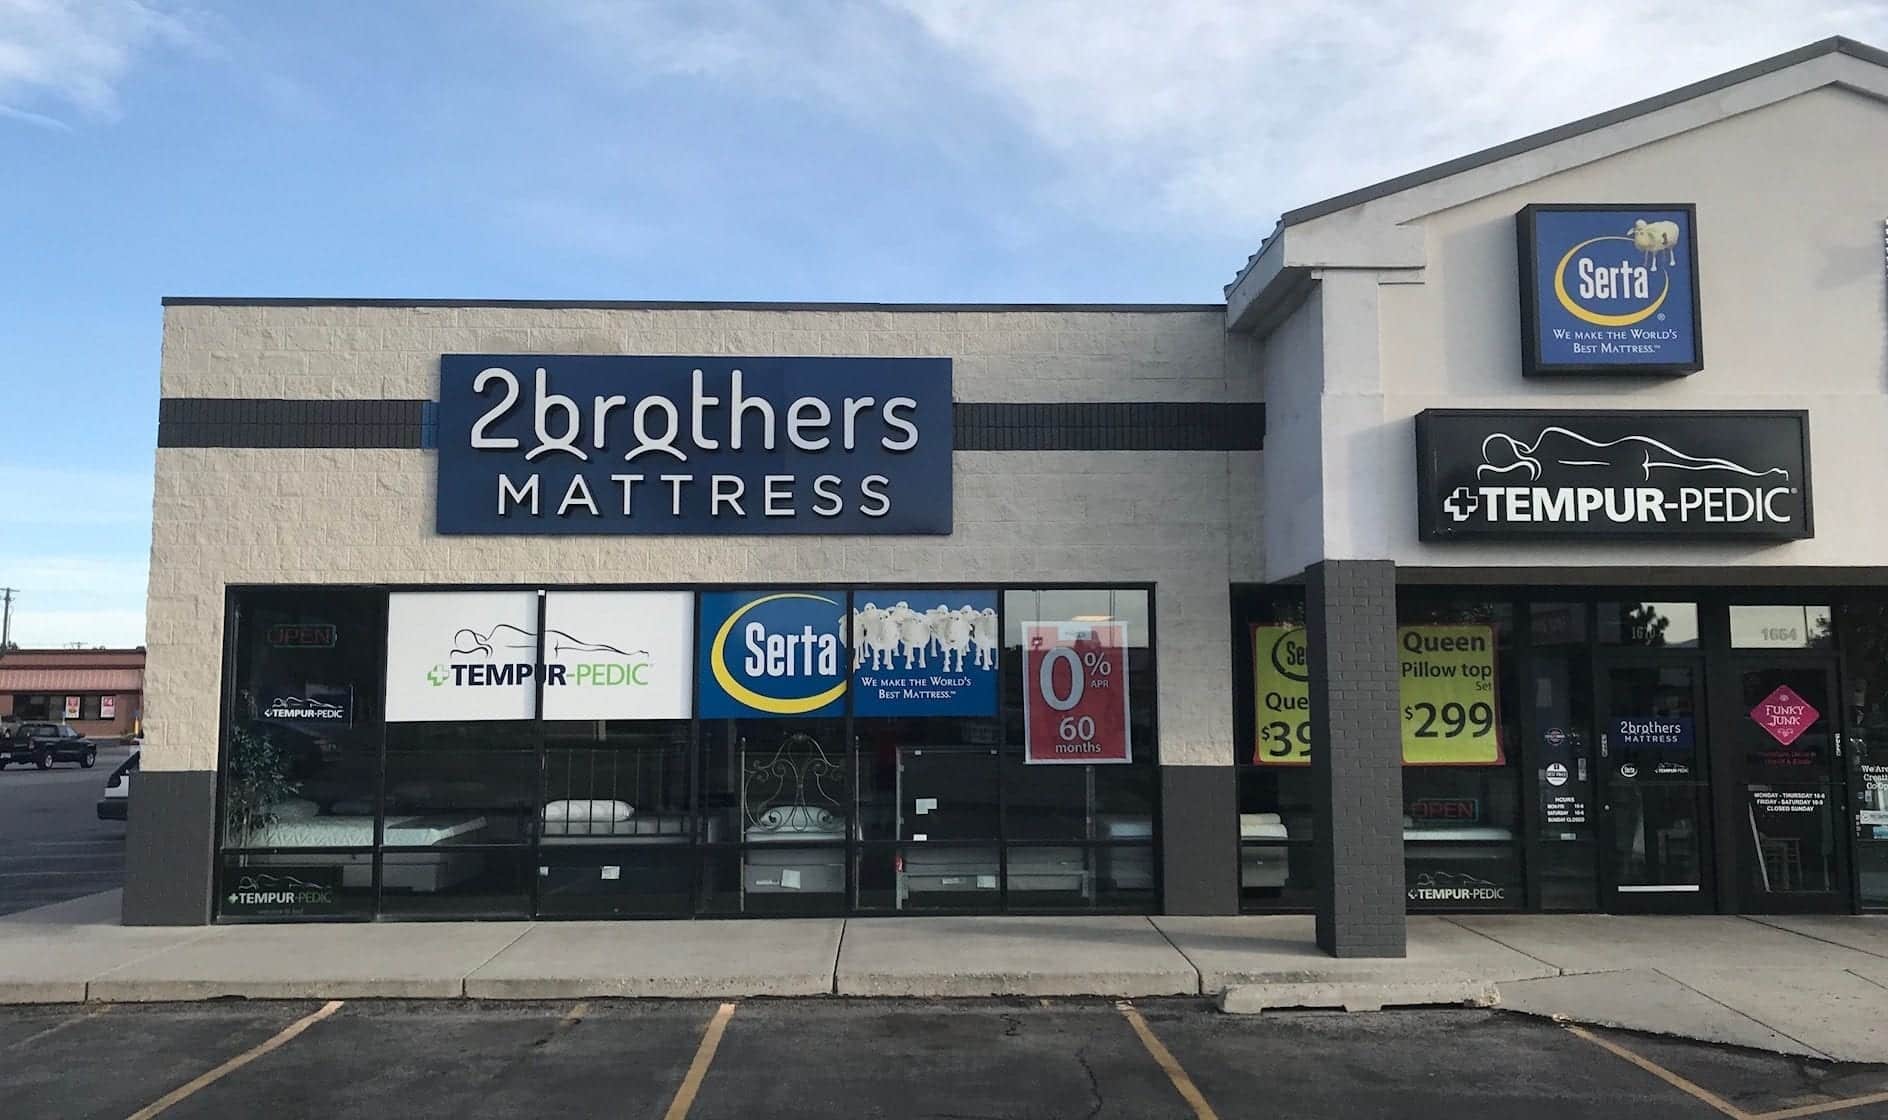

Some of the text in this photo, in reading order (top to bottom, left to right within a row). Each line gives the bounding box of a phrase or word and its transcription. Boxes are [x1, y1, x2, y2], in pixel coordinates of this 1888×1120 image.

[1578, 258, 1649, 300] Serta
[1552, 328, 1678, 340] WE MAKE THE WORLD'S
[1573, 343, 1597, 353] BEST
[470, 367, 920, 461] 2brothers
[498, 473, 892, 517] MATTRESS
[1478, 487, 1791, 523] TEMPUR-PEDIC
[1403, 630, 1485, 654] Queen
[744, 621, 837, 678] Serta
[1402, 661, 1492, 681] Pillow top
[861, 676, 972, 687] WE MAKE THE WORLD'S
[1090, 680, 1109, 688] APR
[1475, 681, 1492, 692] Set
[878, 689, 900, 699] BEST
[1265, 692, 1309, 712] Que
[272, 708, 344, 719] TEMPUR-PEDIC
[1765, 705, 1805, 716] FUNKY
[1404, 701, 1494, 738] $299
[1767, 715, 1801, 727] JUNK
[1059, 715, 1095, 741] 60
[1620, 720, 1681, 735] 2brothers
[1624, 735, 1679, 743] MATTRESS
[1055, 741, 1102, 753] months
[1418, 888, 1505, 900] TEMPUR-PEDIC
